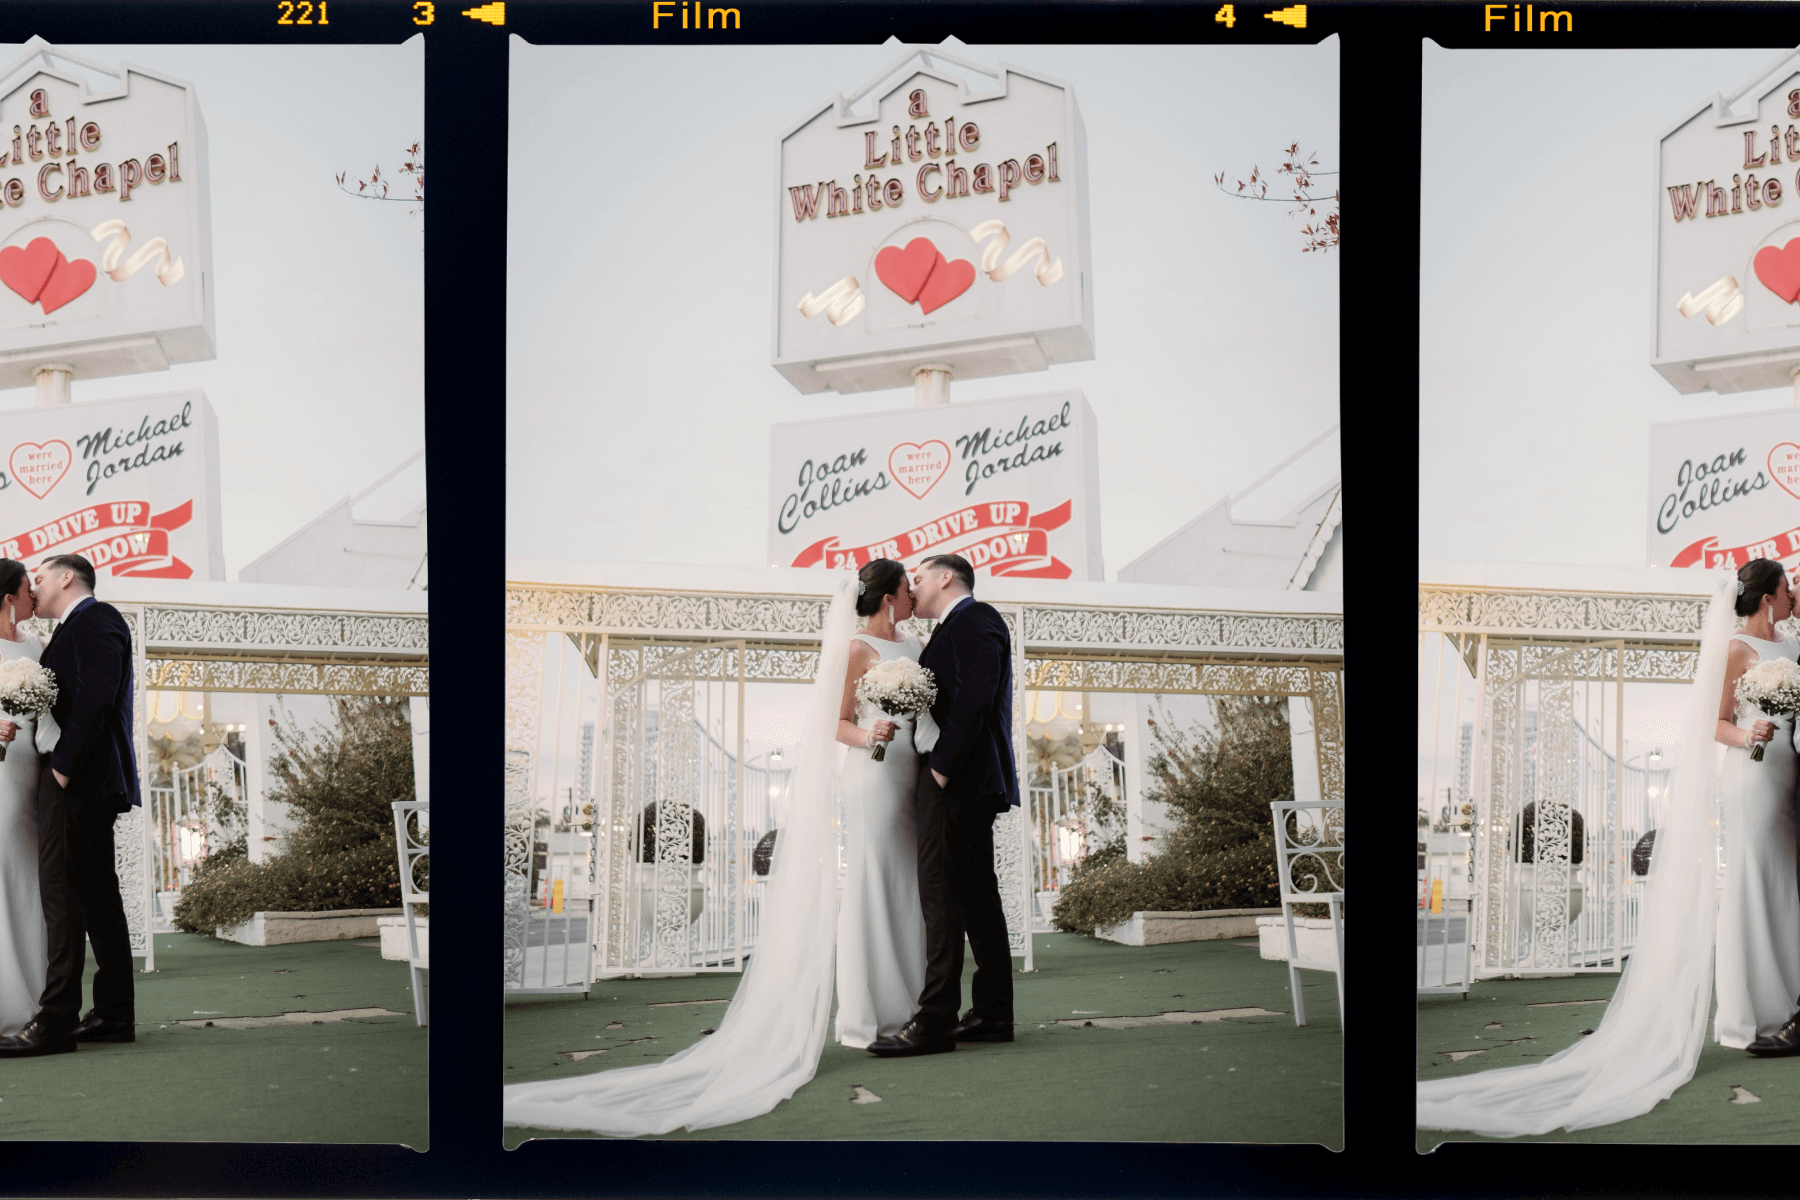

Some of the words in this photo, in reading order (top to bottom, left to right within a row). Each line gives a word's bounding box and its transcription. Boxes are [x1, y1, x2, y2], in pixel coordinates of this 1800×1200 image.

[29, 88, 51, 119] a
[908, 88, 930, 119] a
[0, 115, 102, 168] ittle
[864, 116, 981, 169] Little
[1743, 124, 1800, 170] Lit
[37, 141, 183, 202] Chapel
[788, 173, 904, 222] White
[916, 141, 1062, 202] Chapel
[1667, 173, 1784, 223] White
[77, 400, 192, 460] Michael
[956, 400, 1071, 460] Michael
[19, 460, 64, 474] married
[28, 451, 53, 461] were
[29, 474, 53, 485] here
[86, 441, 185, 496] Jordan
[798, 448, 869, 501] Joan
[898, 460, 942, 474] married
[907, 451, 932, 461] were
[908, 474, 932, 485] here
[965, 441, 1064, 496] Jordan
[1677, 448, 1748, 502] Joan
[28, 508, 100, 552] DRIVE
[110, 502, 143, 524] UP
[778, 471, 891, 535] Collins
[1656, 471, 1770, 535] Collins
[77, 532, 151, 567] NDOW
[867, 539, 903, 561] HR
[908, 508, 979, 552] DRIVE
[989, 502, 1022, 524] UP
[956, 532, 1030, 567] NDOW
[1747, 539, 1782, 561] HR
